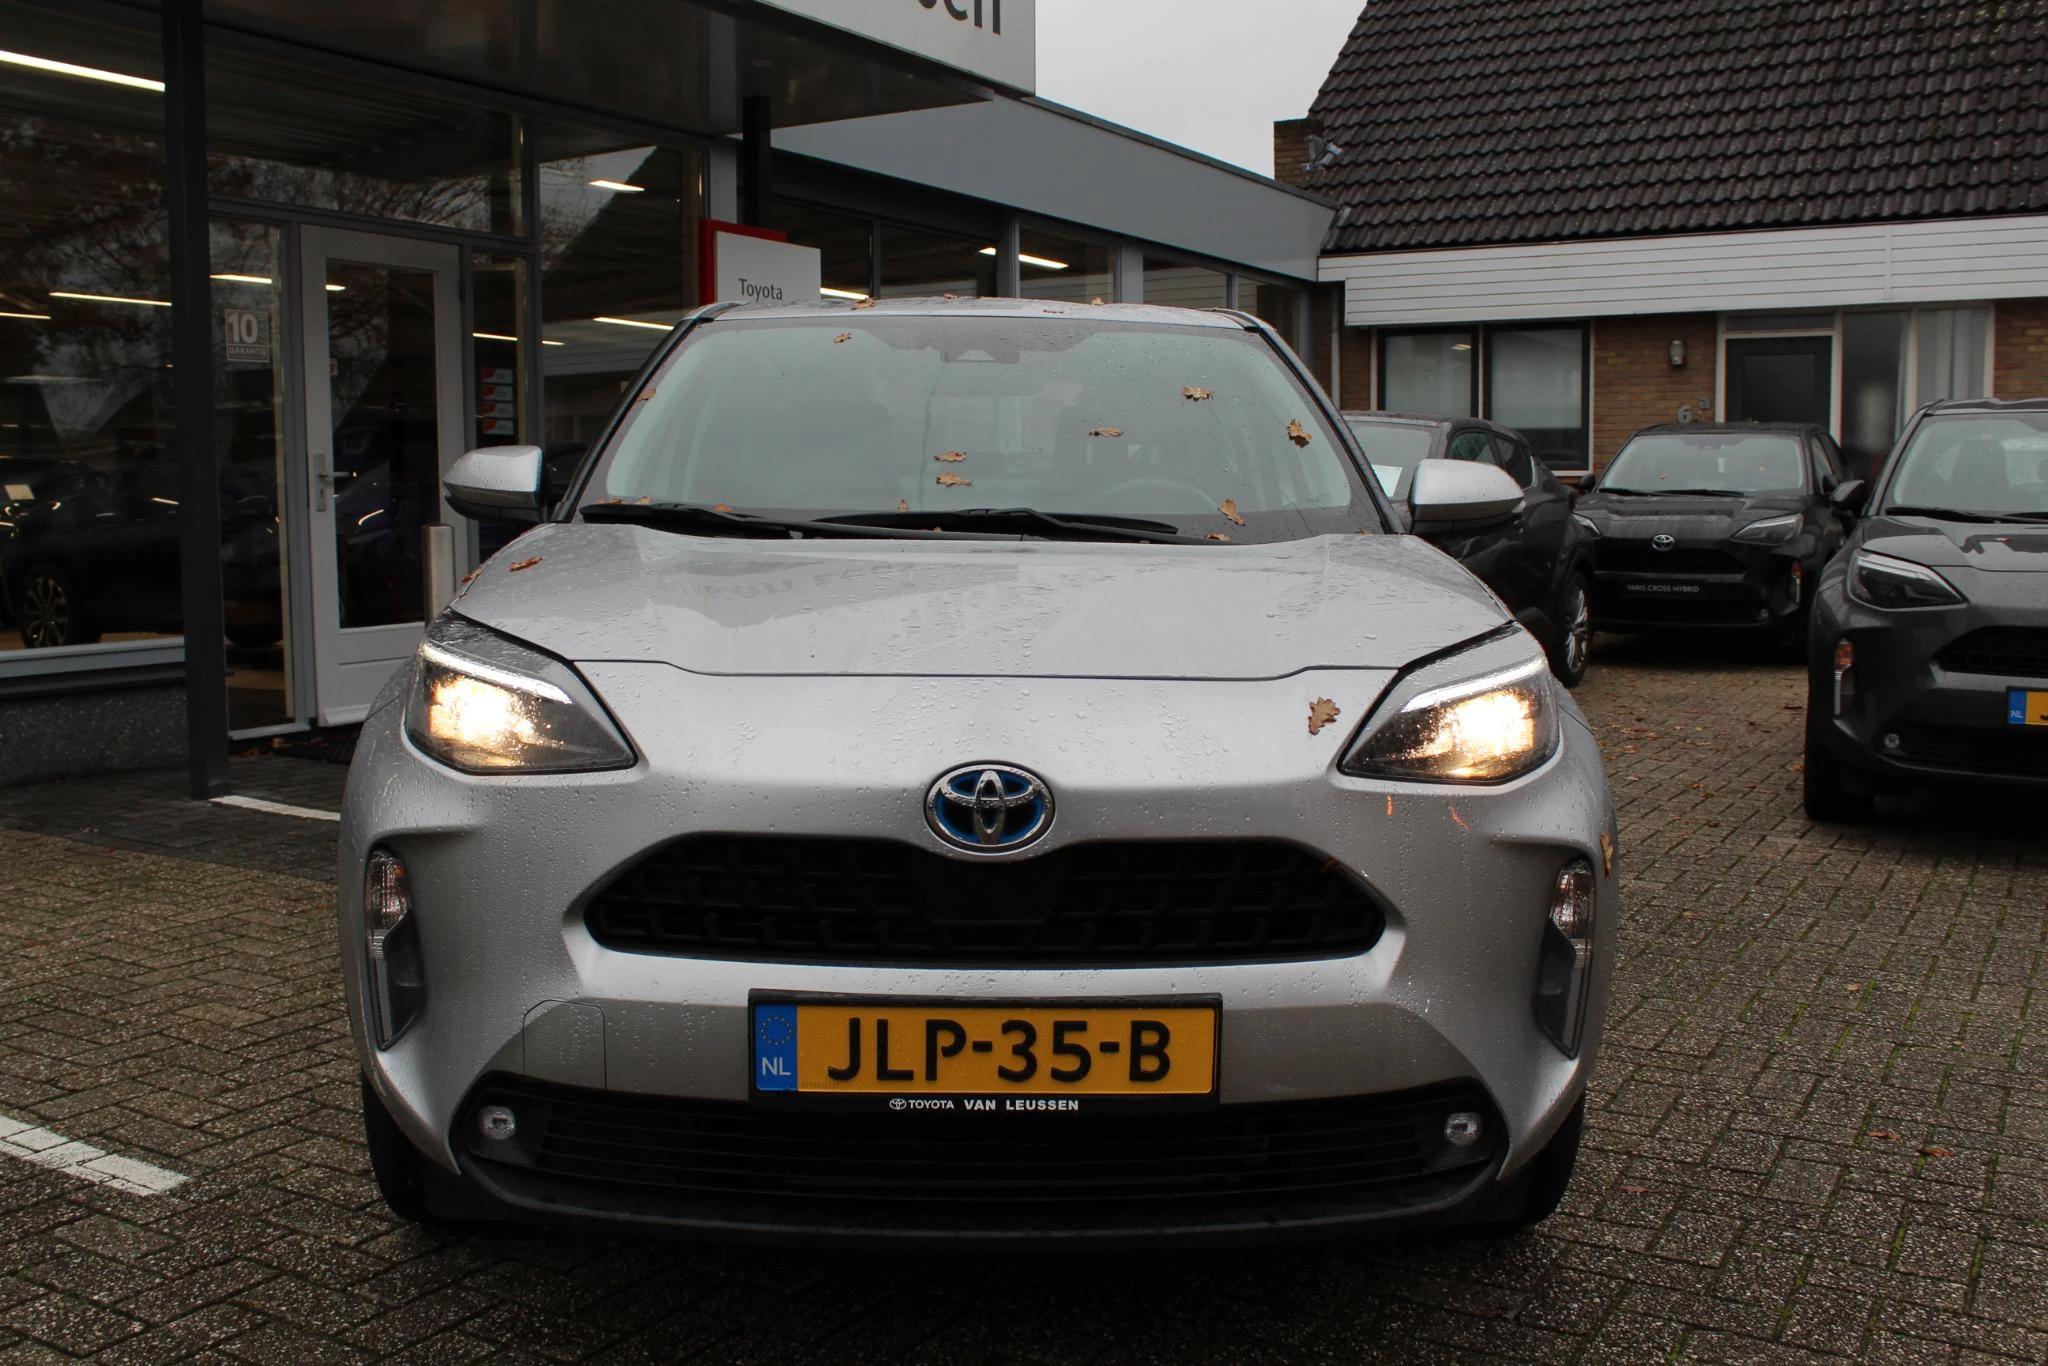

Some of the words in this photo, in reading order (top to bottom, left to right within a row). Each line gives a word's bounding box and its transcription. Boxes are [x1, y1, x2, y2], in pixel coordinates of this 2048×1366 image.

[738, 278, 783, 302] Toyota
[228, 313, 258, 344] 10
[1678, 405, 1691, 424] 6
[1627, 584, 1646, 592] YARIS
[1647, 584, 1671, 592] CROSS
[1673, 585, 1700, 593] HYBRID
[2010, 710, 2024, 718] NL
[828, 1017, 1171, 1083] JLP-35-B
[761, 1057, 791, 1076] NL
[909, 1100, 954, 1109] TOYOTA
[963, 1099, 996, 1111] VAN
[1006, 1099, 1079, 1111] LEUSSEN
